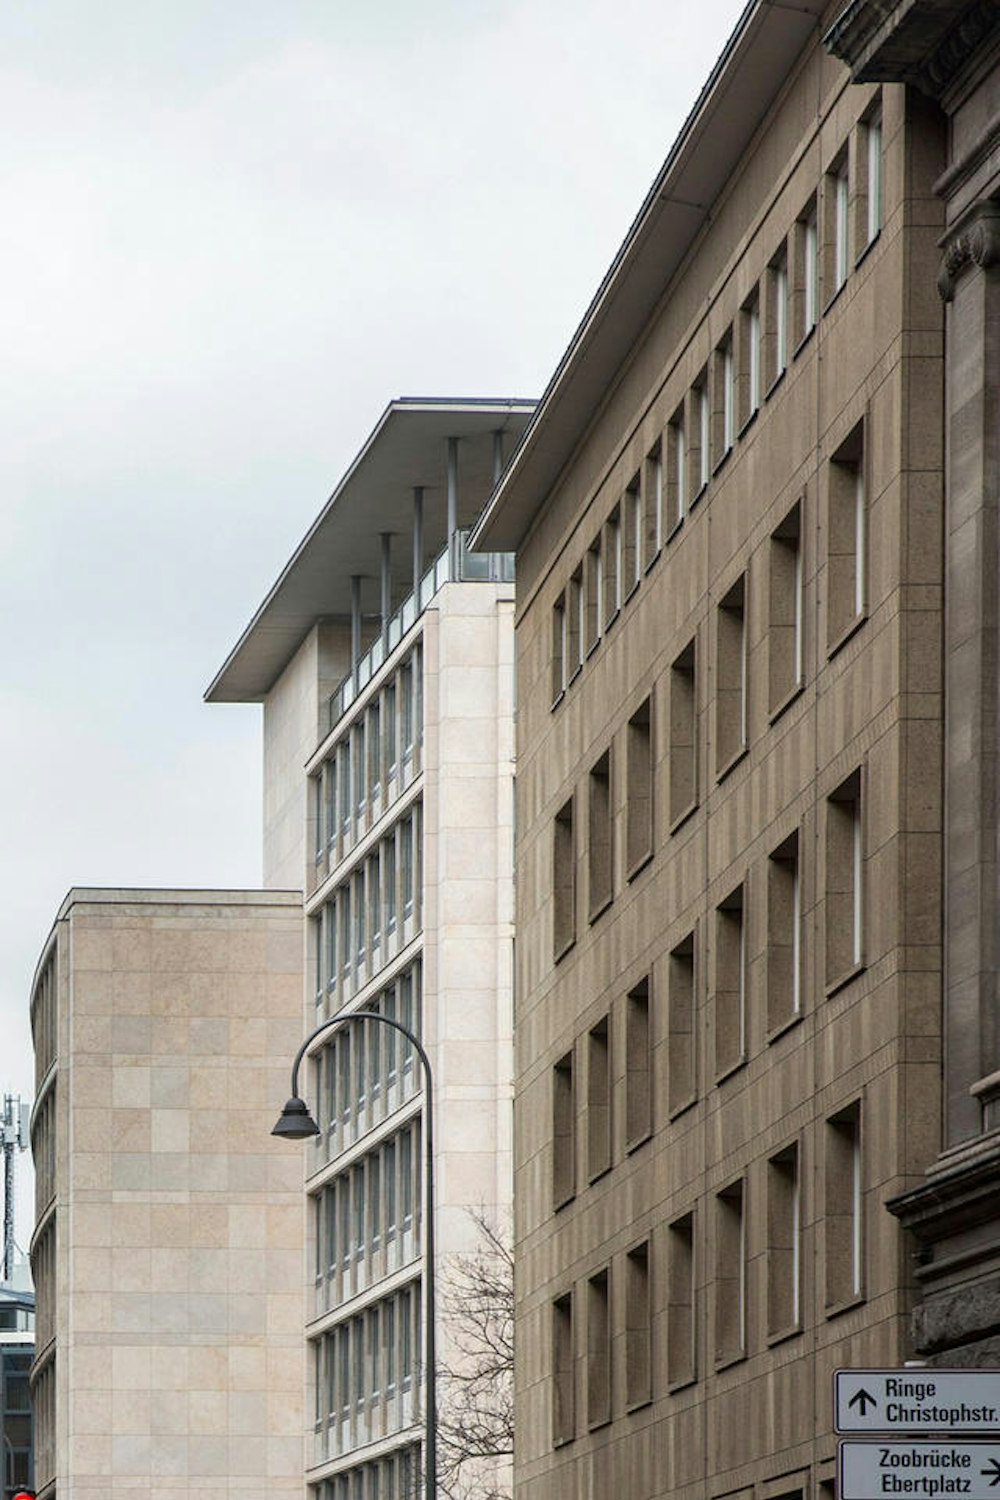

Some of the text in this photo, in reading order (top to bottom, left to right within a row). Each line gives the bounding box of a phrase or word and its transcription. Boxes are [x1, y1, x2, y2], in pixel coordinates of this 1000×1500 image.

[885, 1378, 936, 1401] Ringe
[886, 1403, 999, 1426] Christophstr.
[879, 1449, 971, 1468] Zoobrücke
[881, 1474, 971, 1497] Ebertplatz
